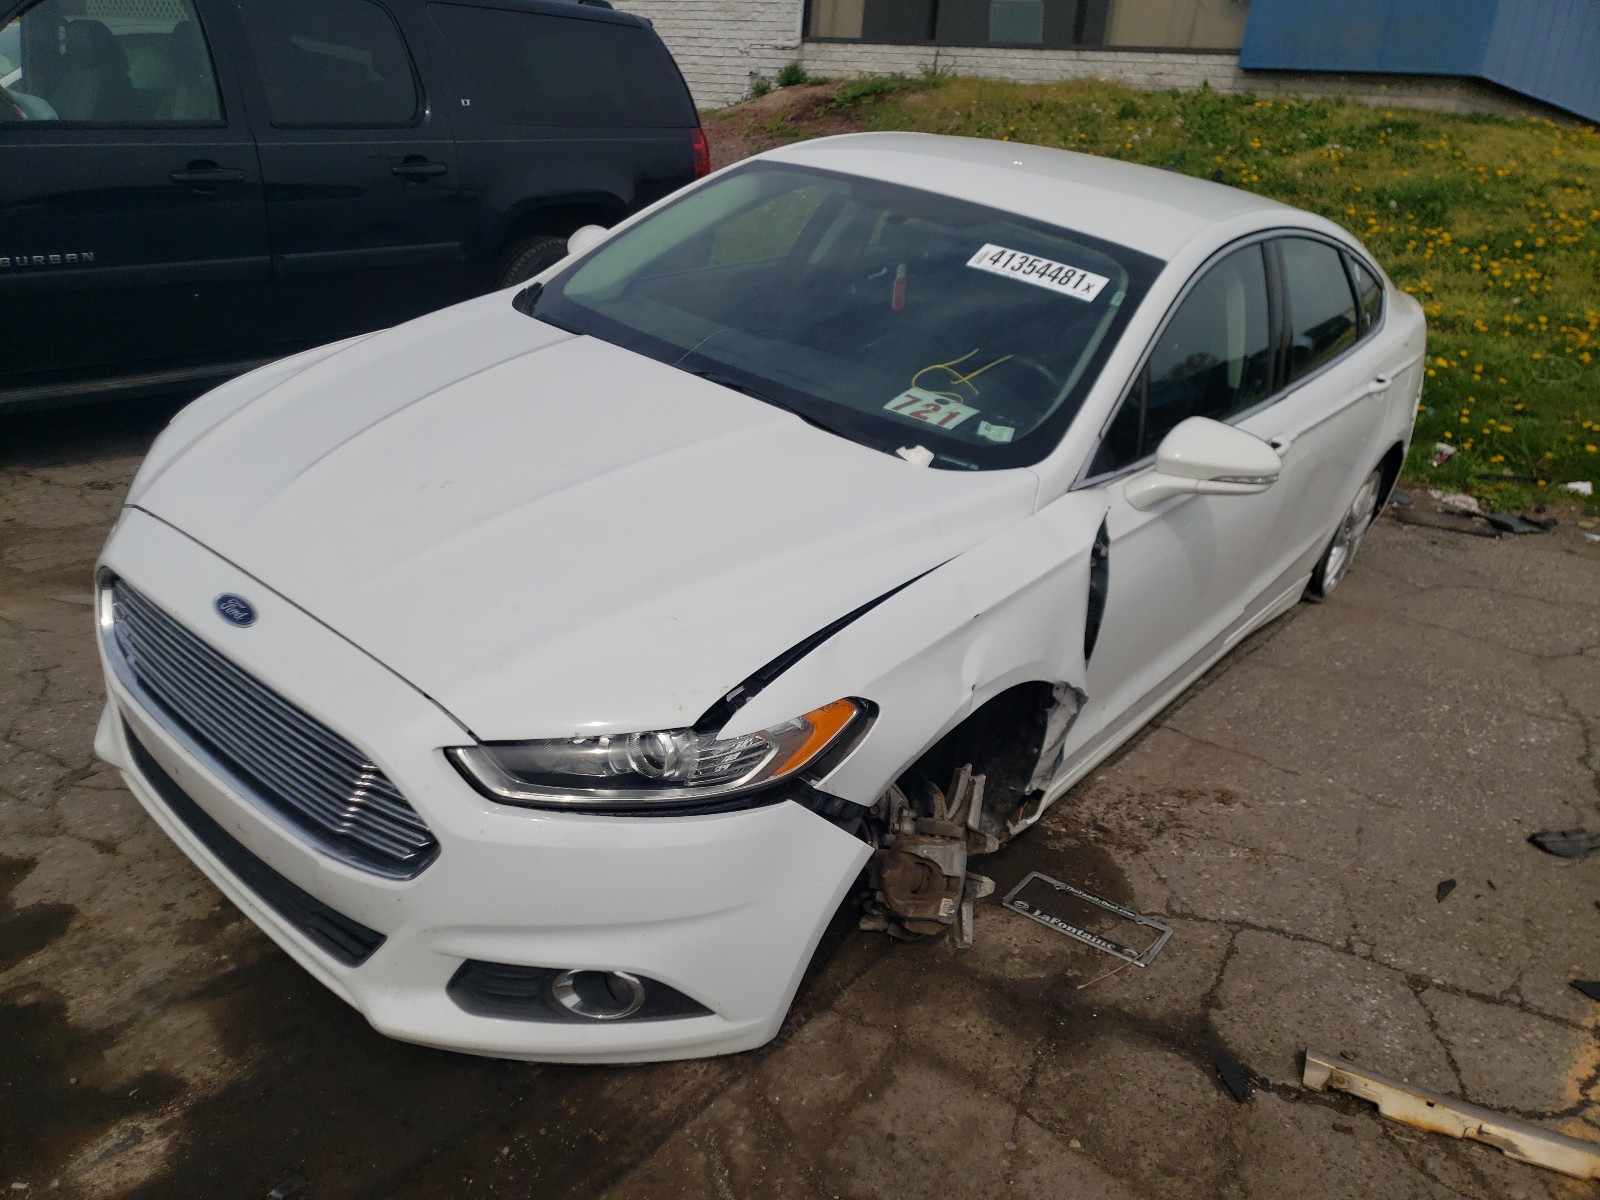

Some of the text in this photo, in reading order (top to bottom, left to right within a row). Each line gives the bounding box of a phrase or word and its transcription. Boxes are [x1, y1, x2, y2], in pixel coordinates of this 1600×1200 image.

[460, 98, 471, 106] LT
[892, 393, 961, 427] 721
[220, 599, 250, 620] Ford
[1031, 909, 1117, 951] LaFontaine
